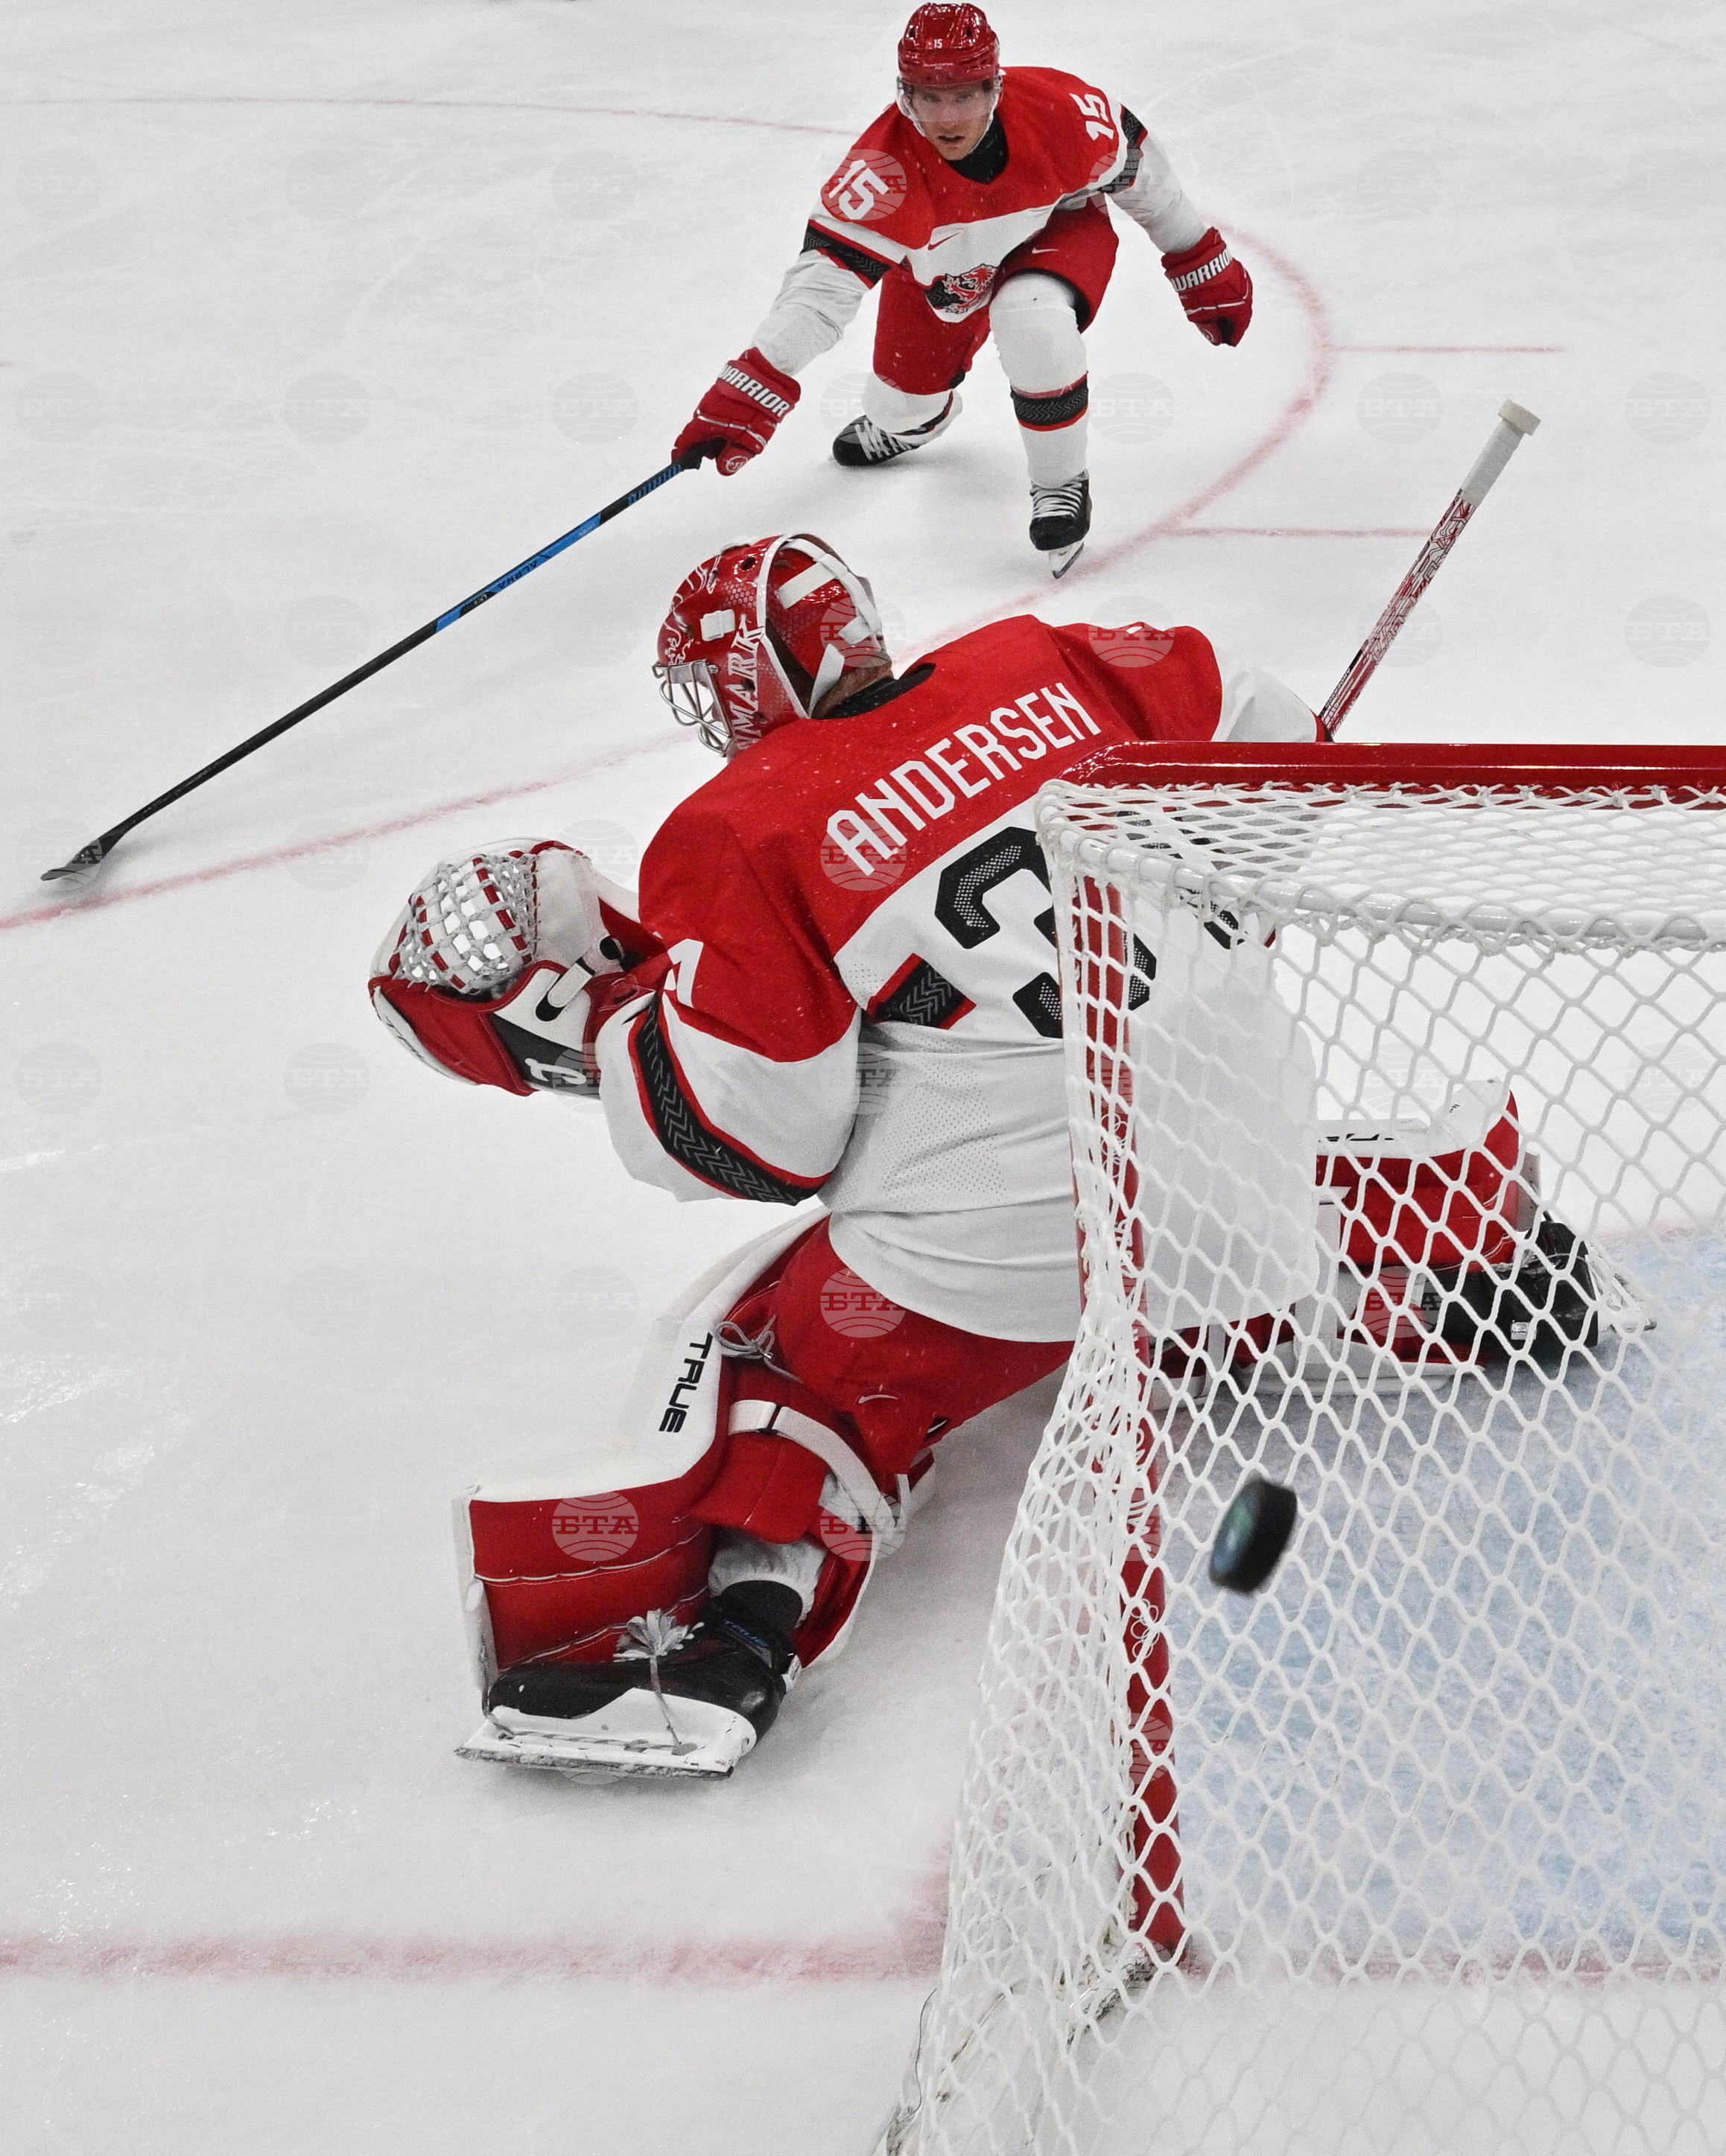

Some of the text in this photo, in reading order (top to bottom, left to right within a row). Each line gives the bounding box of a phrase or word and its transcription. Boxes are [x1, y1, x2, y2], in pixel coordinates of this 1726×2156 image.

[933, 38, 943, 49] 15
[1069, 92, 1114, 141] 15
[828, 159, 889, 220] 15
[1170, 247, 1233, 293] WARRIO
[497, 559, 538, 590] ALPHA
[826, 682, 1102, 877] ANDERSEN
[659, 1332, 713, 1433] TRUE
